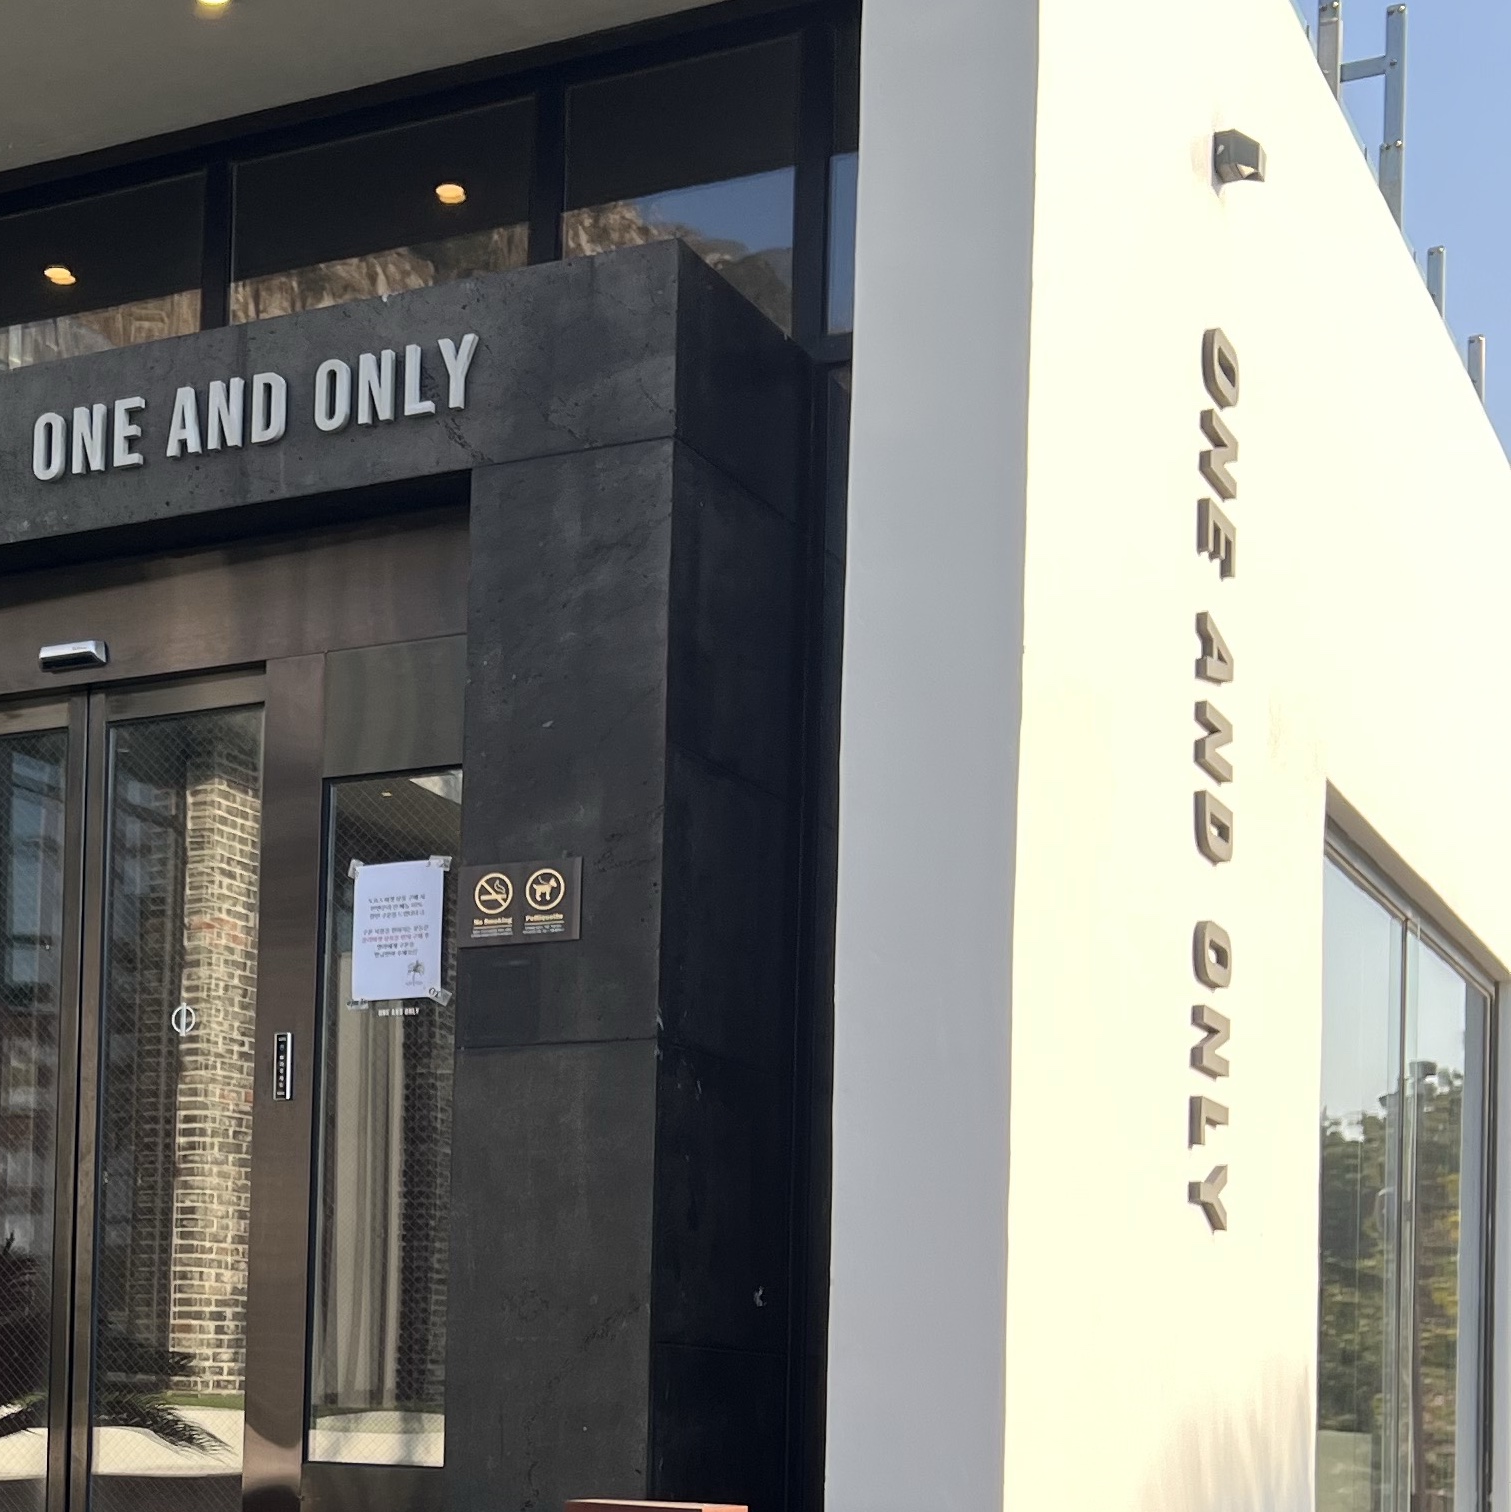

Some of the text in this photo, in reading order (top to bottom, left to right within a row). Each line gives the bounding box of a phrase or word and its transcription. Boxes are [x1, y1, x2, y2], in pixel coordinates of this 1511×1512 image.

[32, 332, 479, 481] ONE AND ONLY
[1188, 327, 1240, 1232] ONE AND ONLY
